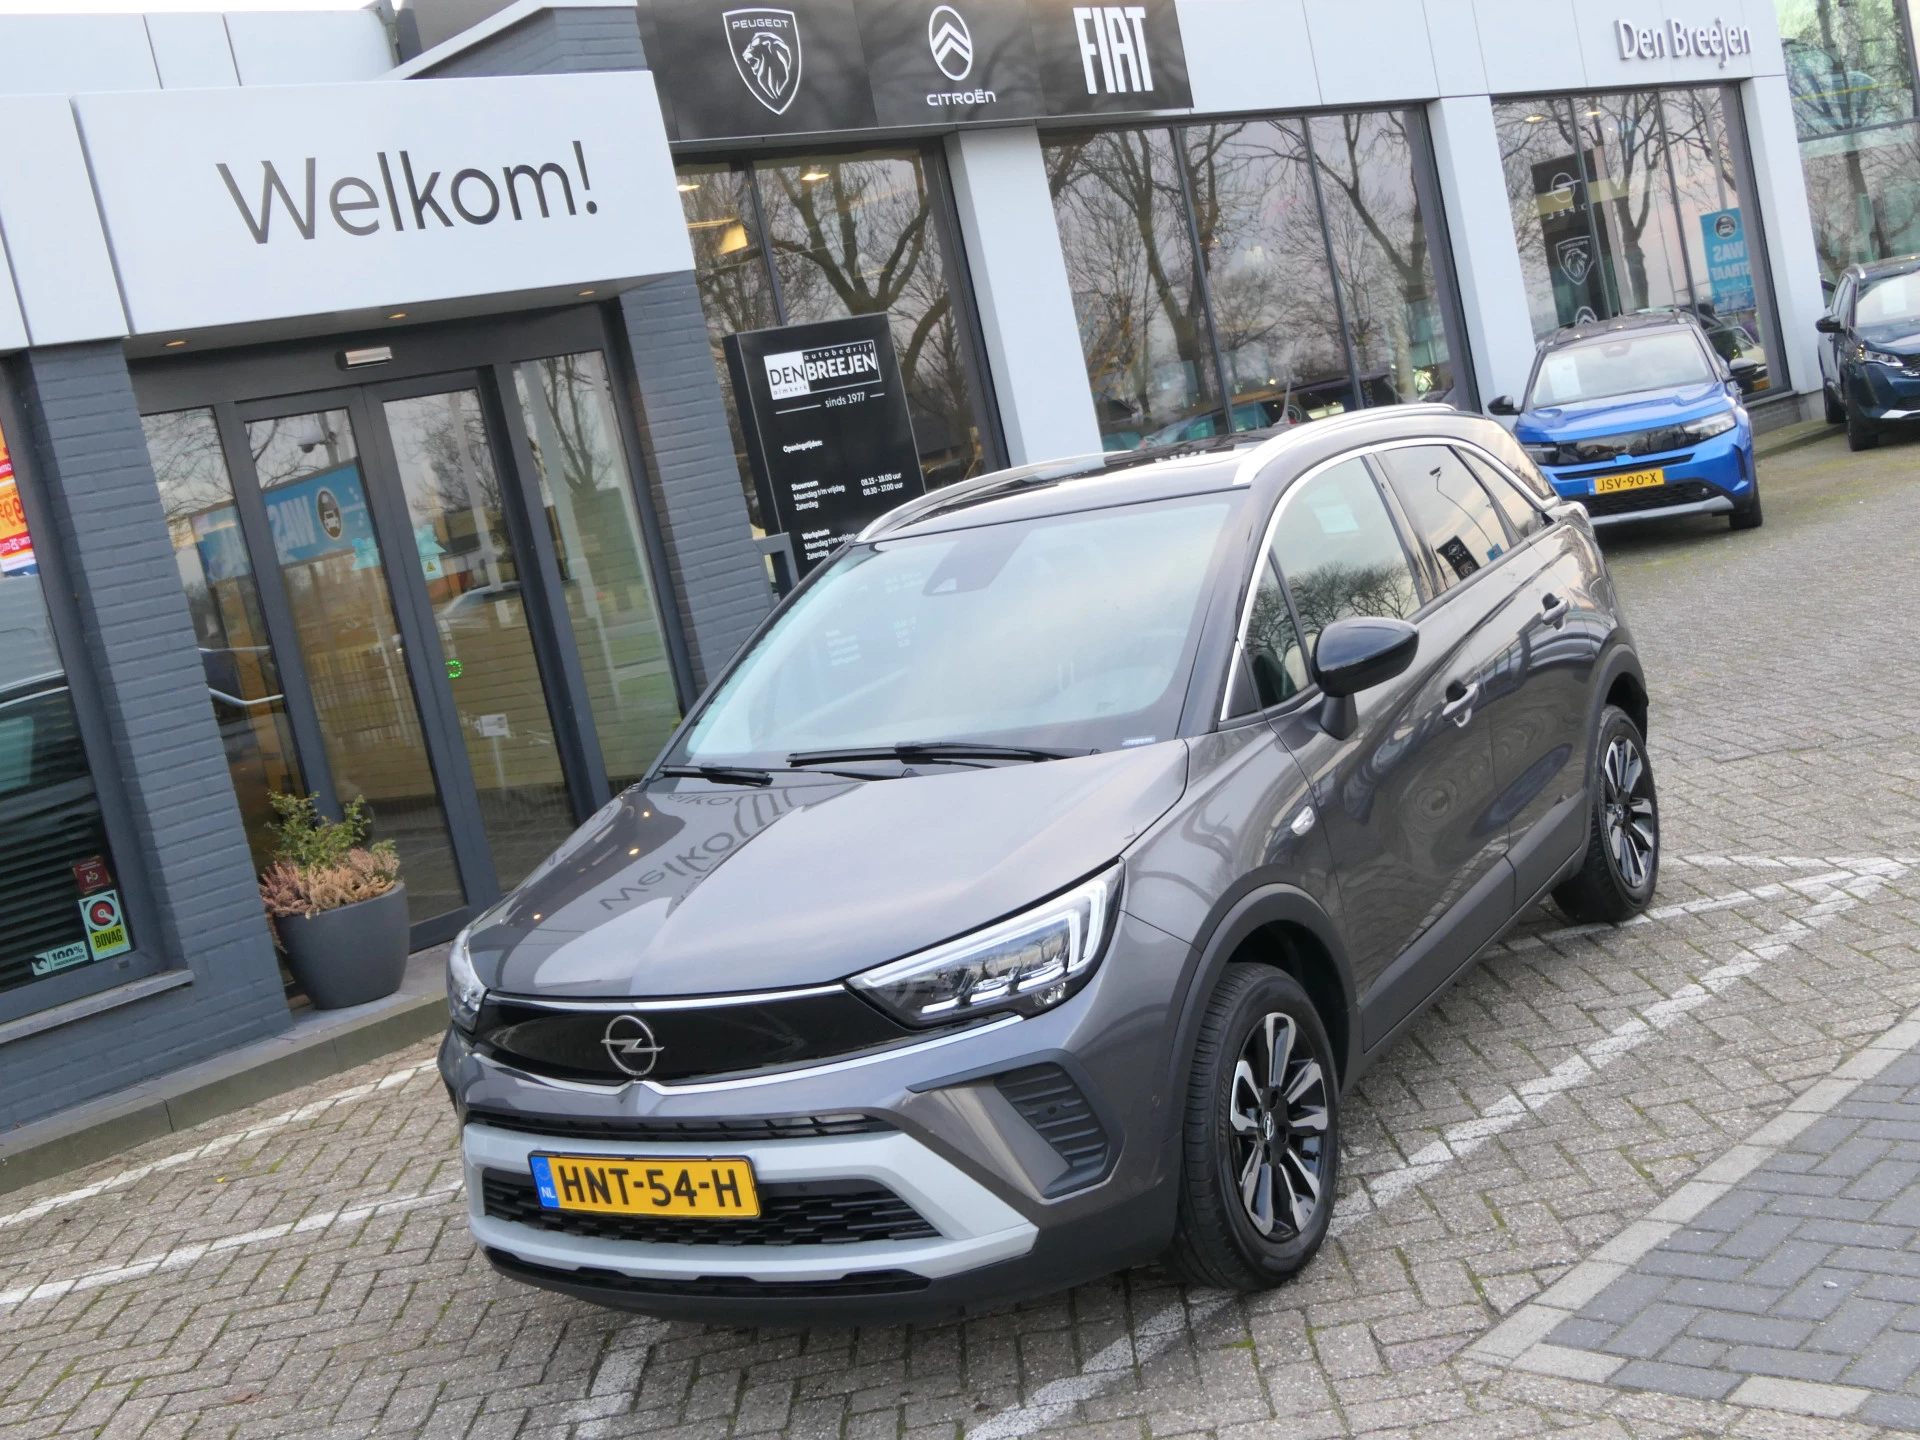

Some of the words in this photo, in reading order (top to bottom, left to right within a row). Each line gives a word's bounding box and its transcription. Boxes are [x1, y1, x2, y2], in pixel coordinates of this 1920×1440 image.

[731, 18, 789, 30] PEUGEOT
[1072, 7, 1153, 94] FIAT
[1614, 19, 1666, 60] Den
[1667, 17, 1751, 69] Breejen
[215, 140, 598, 244] Welkom!
[804, 343, 874, 360] autobedrijf
[769, 364, 807, 387] DEN
[805, 352, 878, 381] BREEJEN
[825, 396, 846, 408] sinds
[848, 392, 865, 404] 1977
[791, 480, 819, 491] Showroom
[1599, 472, 1658, 492] JSV-90-X
[793, 490, 818, 501] Maandag
[827, 484, 845, 495] vrijdag
[795, 500, 819, 511] Zaterdag
[801, 529, 830, 540] Werkplaats
[804, 540, 829, 550] Maandag
[806, 550, 829, 560] Zaterdag
[95, 928, 123, 949] BOVAG
[52, 945, 84, 961] 100%
[541, 1187, 556, 1200] NL
[558, 1165, 742, 1208] HNT-54-H
